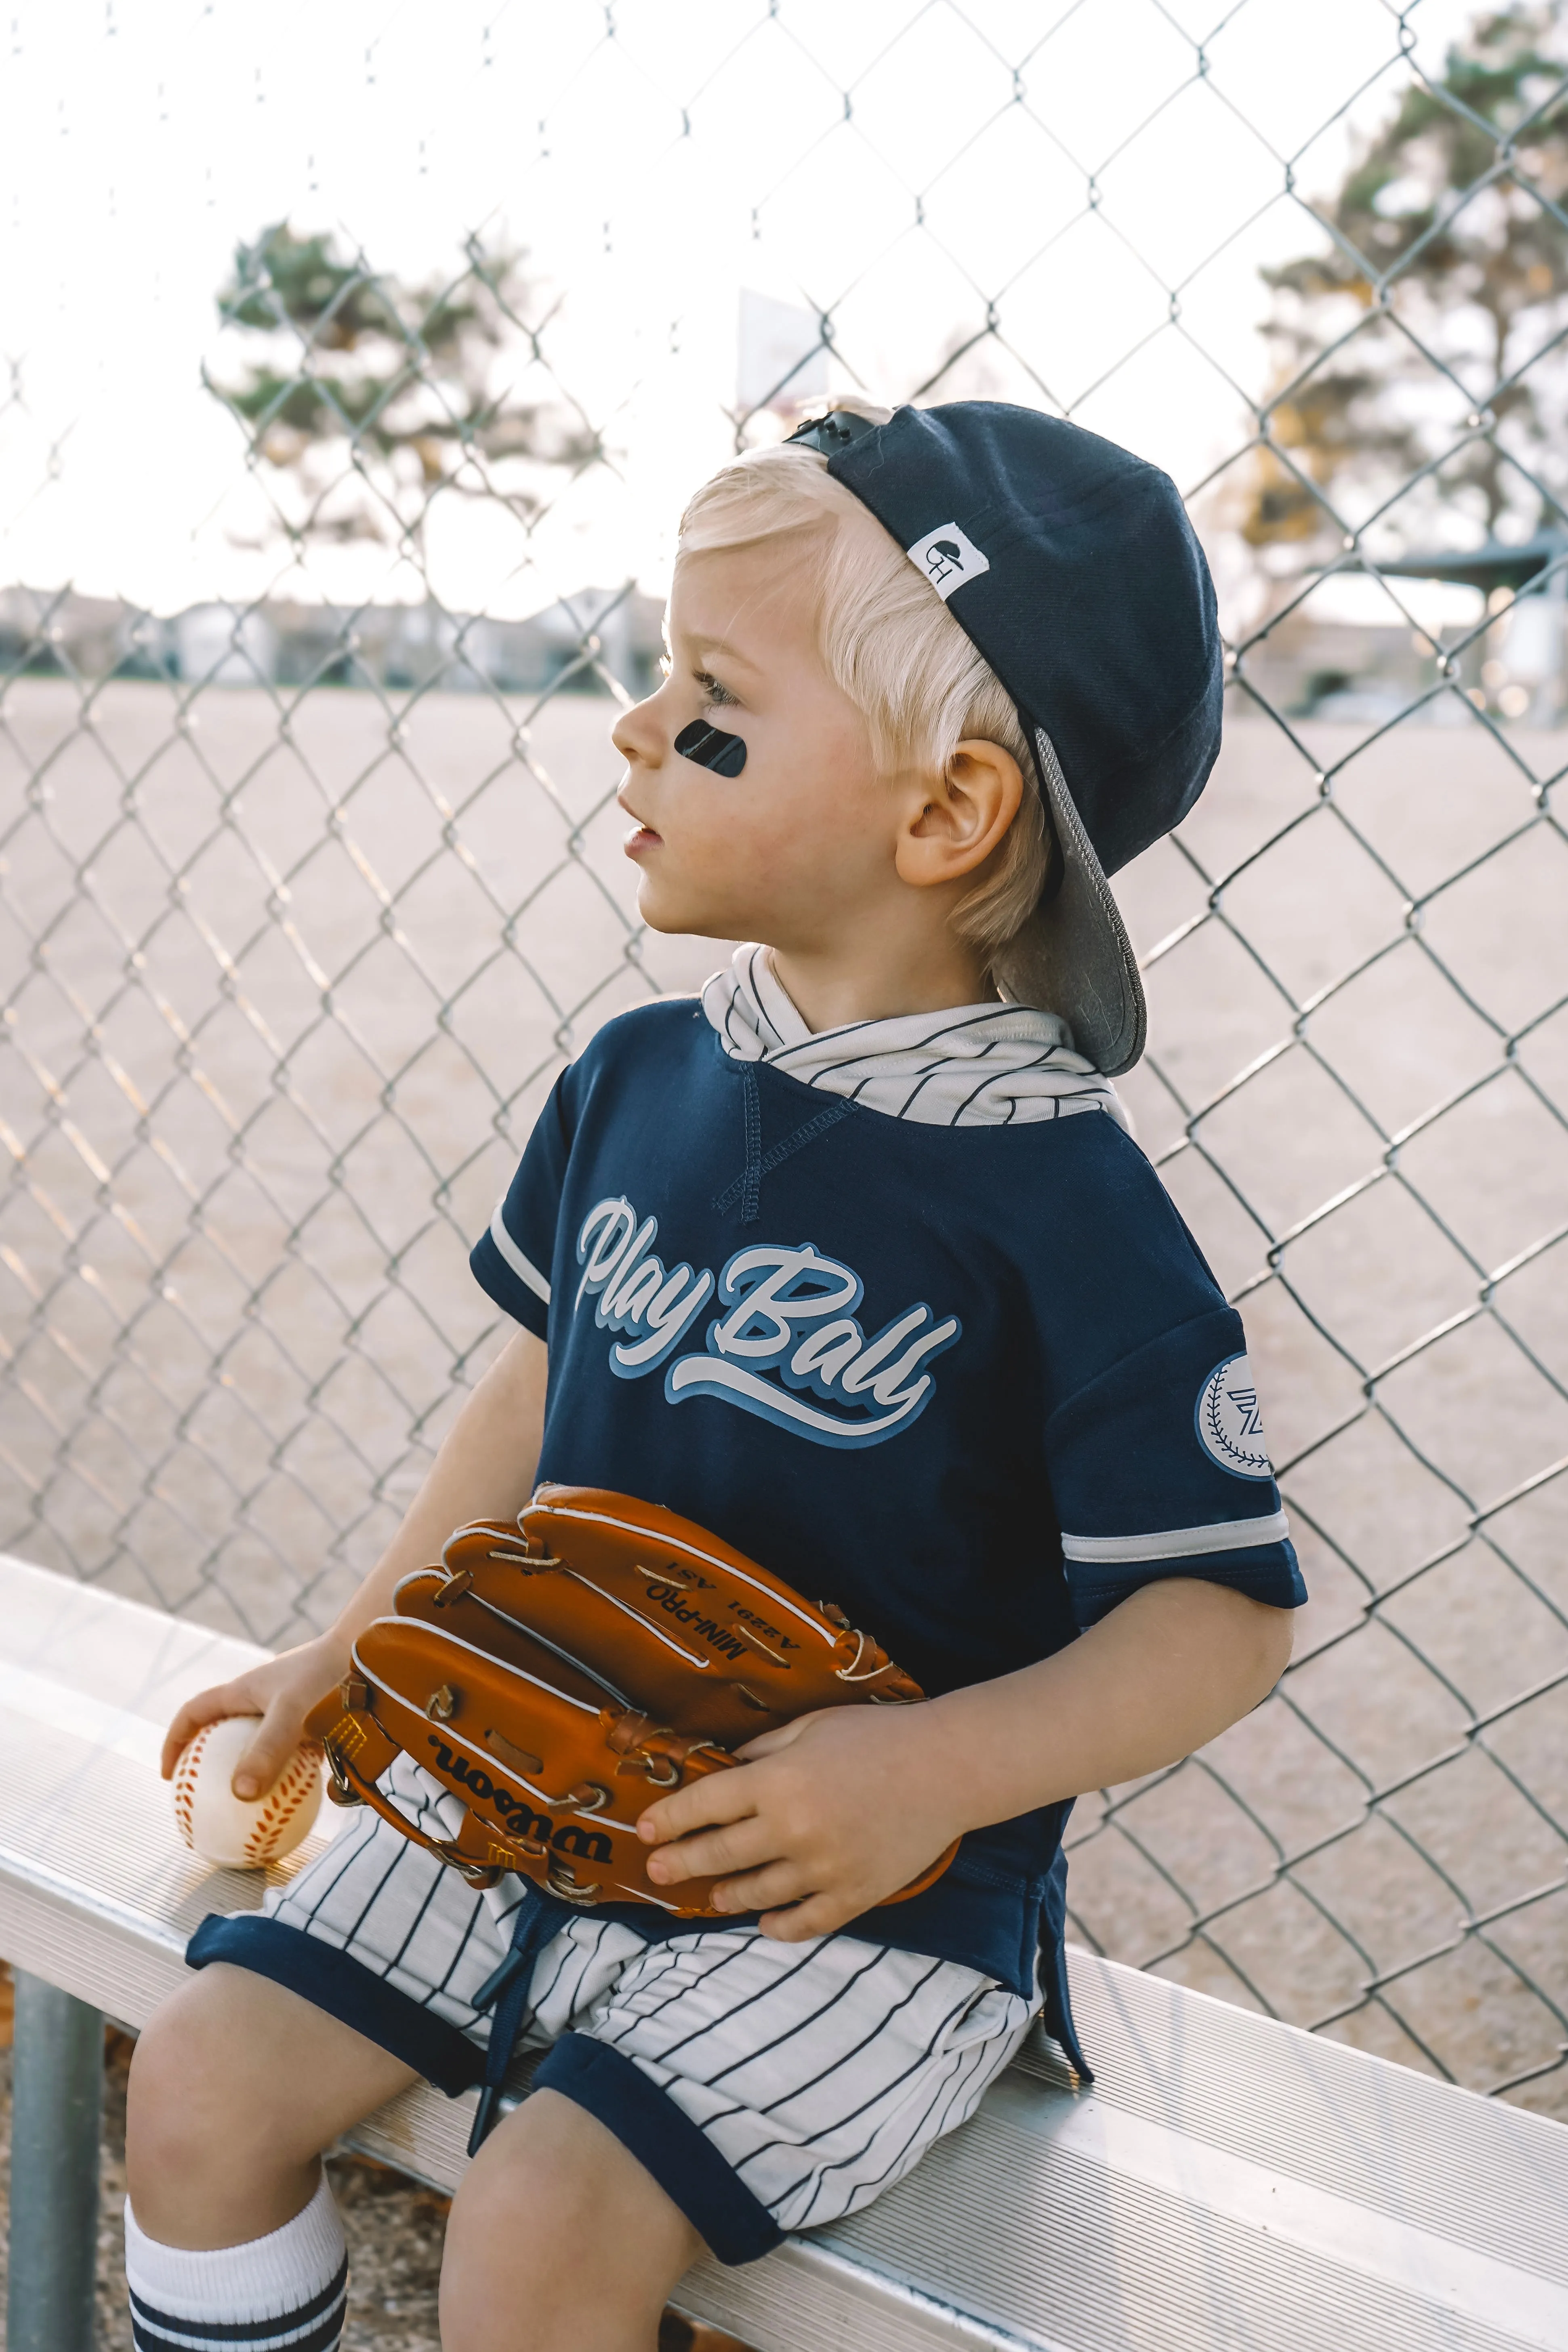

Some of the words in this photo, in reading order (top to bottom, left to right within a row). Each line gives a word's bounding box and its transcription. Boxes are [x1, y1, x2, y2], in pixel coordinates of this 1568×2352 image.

[576, 1195, 713, 1373] Play
[668, 1243, 960, 1443] Ball
[647, 1585, 748, 1660] MINI-PRO
[728, 1600, 801, 1649] A2291
